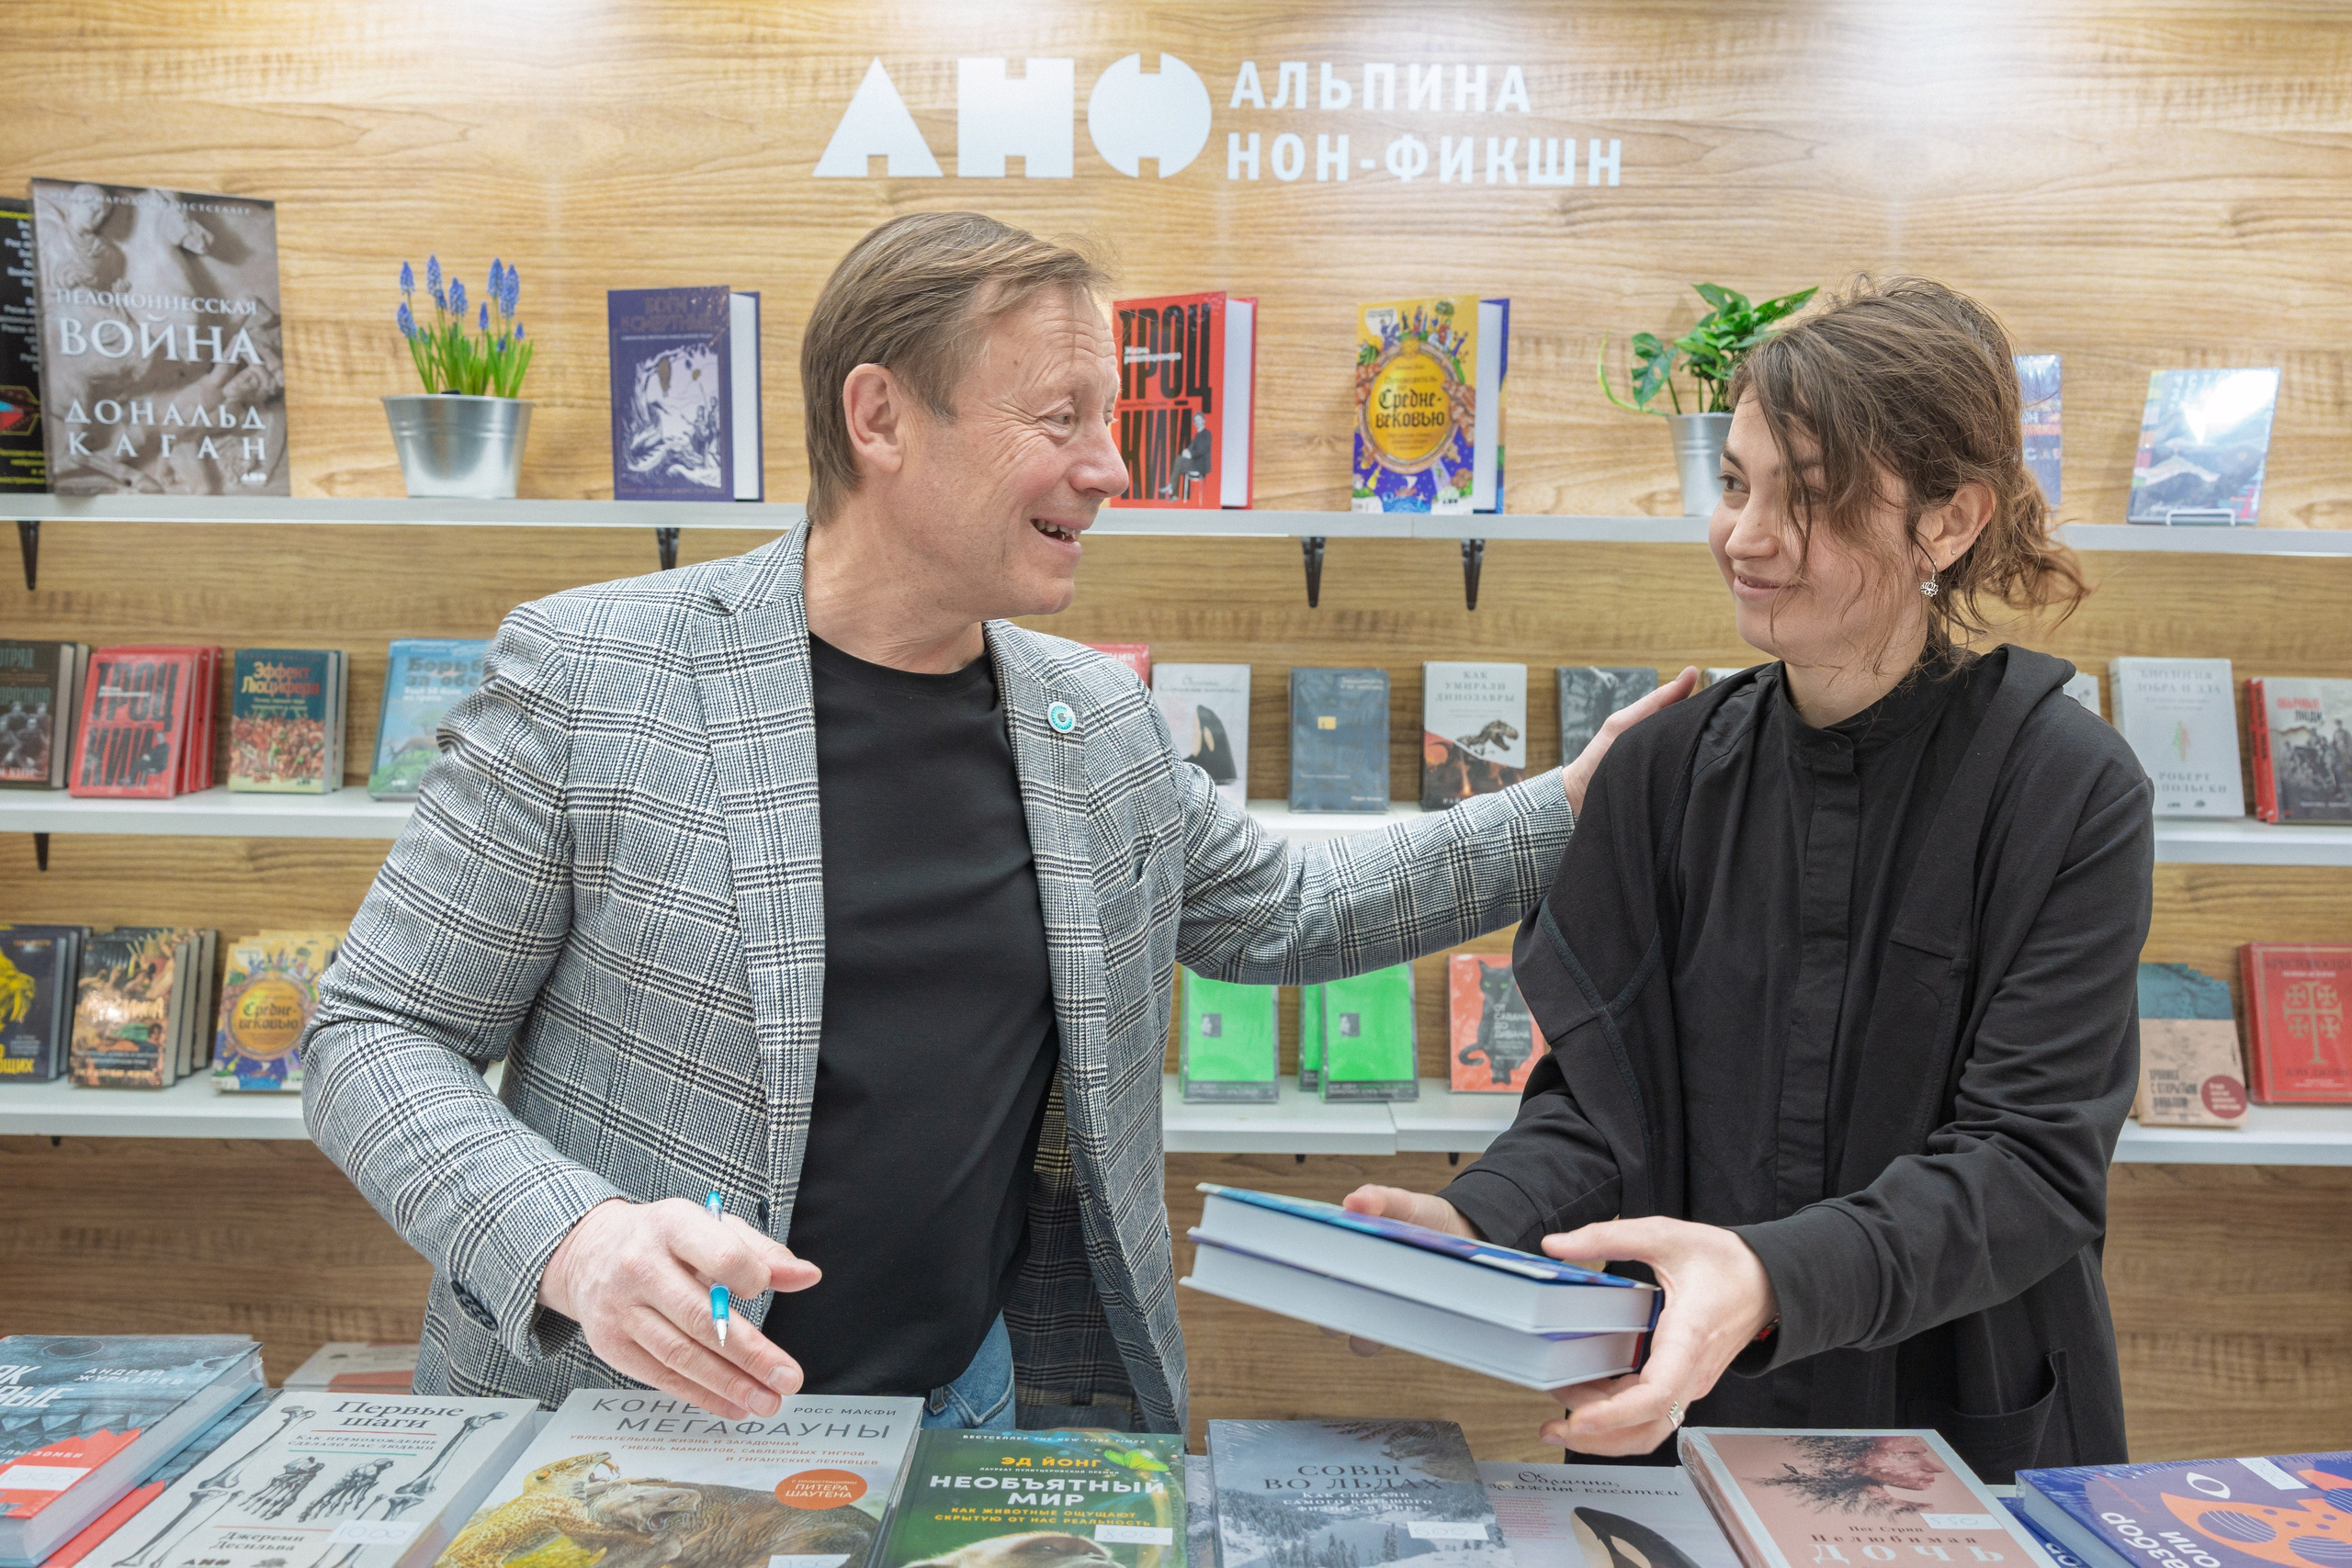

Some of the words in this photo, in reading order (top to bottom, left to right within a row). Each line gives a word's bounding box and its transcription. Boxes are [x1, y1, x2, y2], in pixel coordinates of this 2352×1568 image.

[1230, 61, 1532, 112] АЛЬПИНА
[1227, 131, 1623, 187] НОН-ФИКШН
[59, 313, 265, 366] ВОЙНА
[1378, 388, 1442, 413] Средне-
[64, 399, 266, 430] ДОНАЛЬД
[1375, 411, 1445, 429] вековью
[68, 431, 266, 460] КАГАН
[408, 656, 483, 676] Борьб
[84, 1368, 167, 1378] АНДРЕЙ
[332, 1401, 466, 1418] Первые
[591, 1397, 714, 1416] КОНЕ
[793, 1406, 834, 1415] РОСС
[840, 1408, 898, 1416] МАКФИ
[339, 1416, 432, 1429] шаги
[616, 1416, 891, 1439] МЕГАФАУНЫ
[569, 1434, 665, 1443] УВЛЕКАТЕЛЬНАЯ
[725, 1438, 799, 1447] ЗАГАДОЧНАЯ
[671, 1446, 737, 1454] МАМОНТОВ,
[741, 1448, 818, 1456] САБЛЕЗУБЫХ
[737, 1456, 812, 1464] ГИГАНТСКИХ
[815, 1458, 879, 1466] ЛЕНИВЦЕВ
[1001, 1456, 1033, 1468] ЭД
[1041, 1456, 1102, 1468] ЙОНГ
[1297, 1464, 1402, 1476] СОВЫ
[929, 1474, 1165, 1495] НЕОБЪЯТНЫЙ
[1263, 1477, 1312, 1490] ВО
[1326, 1477, 1444, 1491] ЛЬДАХ
[1584, 1486, 1684, 1496] косатки
[785, 1490, 853, 1498] ШАУТЕНА
[1007, 1492, 1085, 1506] МИР
[981, 1507, 1058, 1517] ЖИВОТНЫЕ
[1063, 1510, 1136, 1518] ОЩУЩАЮТ
[934, 1514, 1003, 1522] СКРЫТУЮ
[1063, 1517, 1151, 1528] РЕАЛЬНОСТЬ
[218, 1531, 307, 1542] Джереми
[1811, 1533, 1978, 1544] Нелюбимая
[208, 1540, 297, 1551] Десильва
[1807, 1543, 2006, 1565] ДОЧЬ
